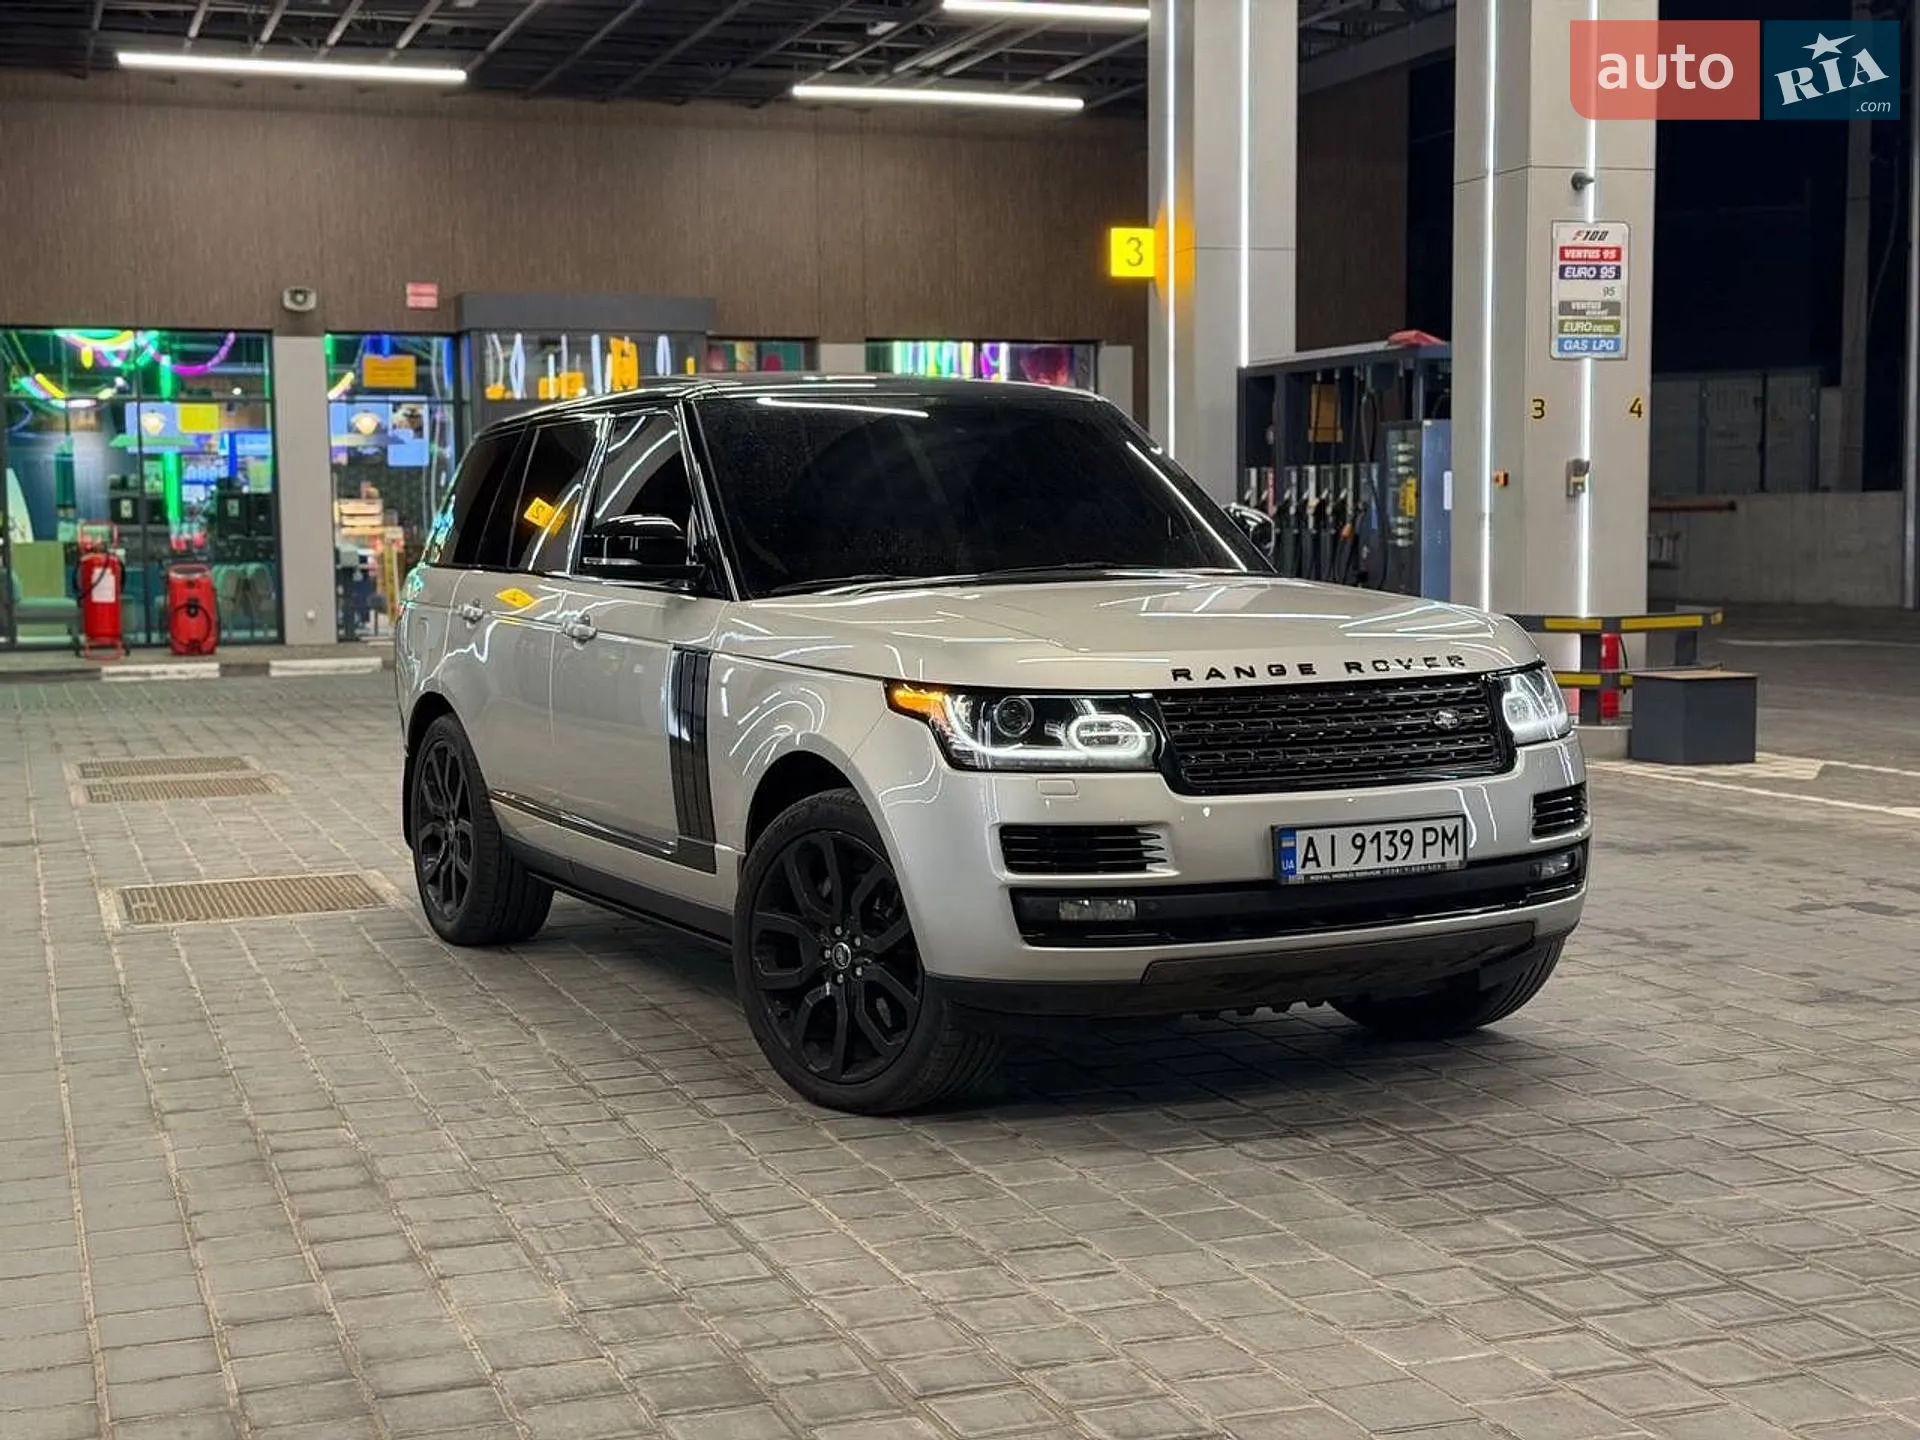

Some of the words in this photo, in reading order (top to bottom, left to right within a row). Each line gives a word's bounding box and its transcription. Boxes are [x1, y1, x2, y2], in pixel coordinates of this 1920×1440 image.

[1572, 230, 1609, 241] F100
[1126, 236, 1143, 267] 3
[1602, 248, 1617, 259] 95
[1564, 266, 1597, 279] EURO
[1600, 266, 1616, 279] 95
[1603, 286, 1617, 297] 95
[1563, 321, 1593, 333] EURO
[1564, 339, 1588, 351] GAS
[1592, 339, 1615, 351] LPG
[1532, 398, 1545, 420] 3
[1629, 397, 1643, 419] 4
[1171, 663, 1317, 682] RANGE
[1344, 654, 1466, 675] ROVER
[1301, 834, 1336, 869] AI
[1352, 828, 1414, 865] 9139
[1422, 824, 1459, 859] PM
[1281, 859, 1296, 871] UA
